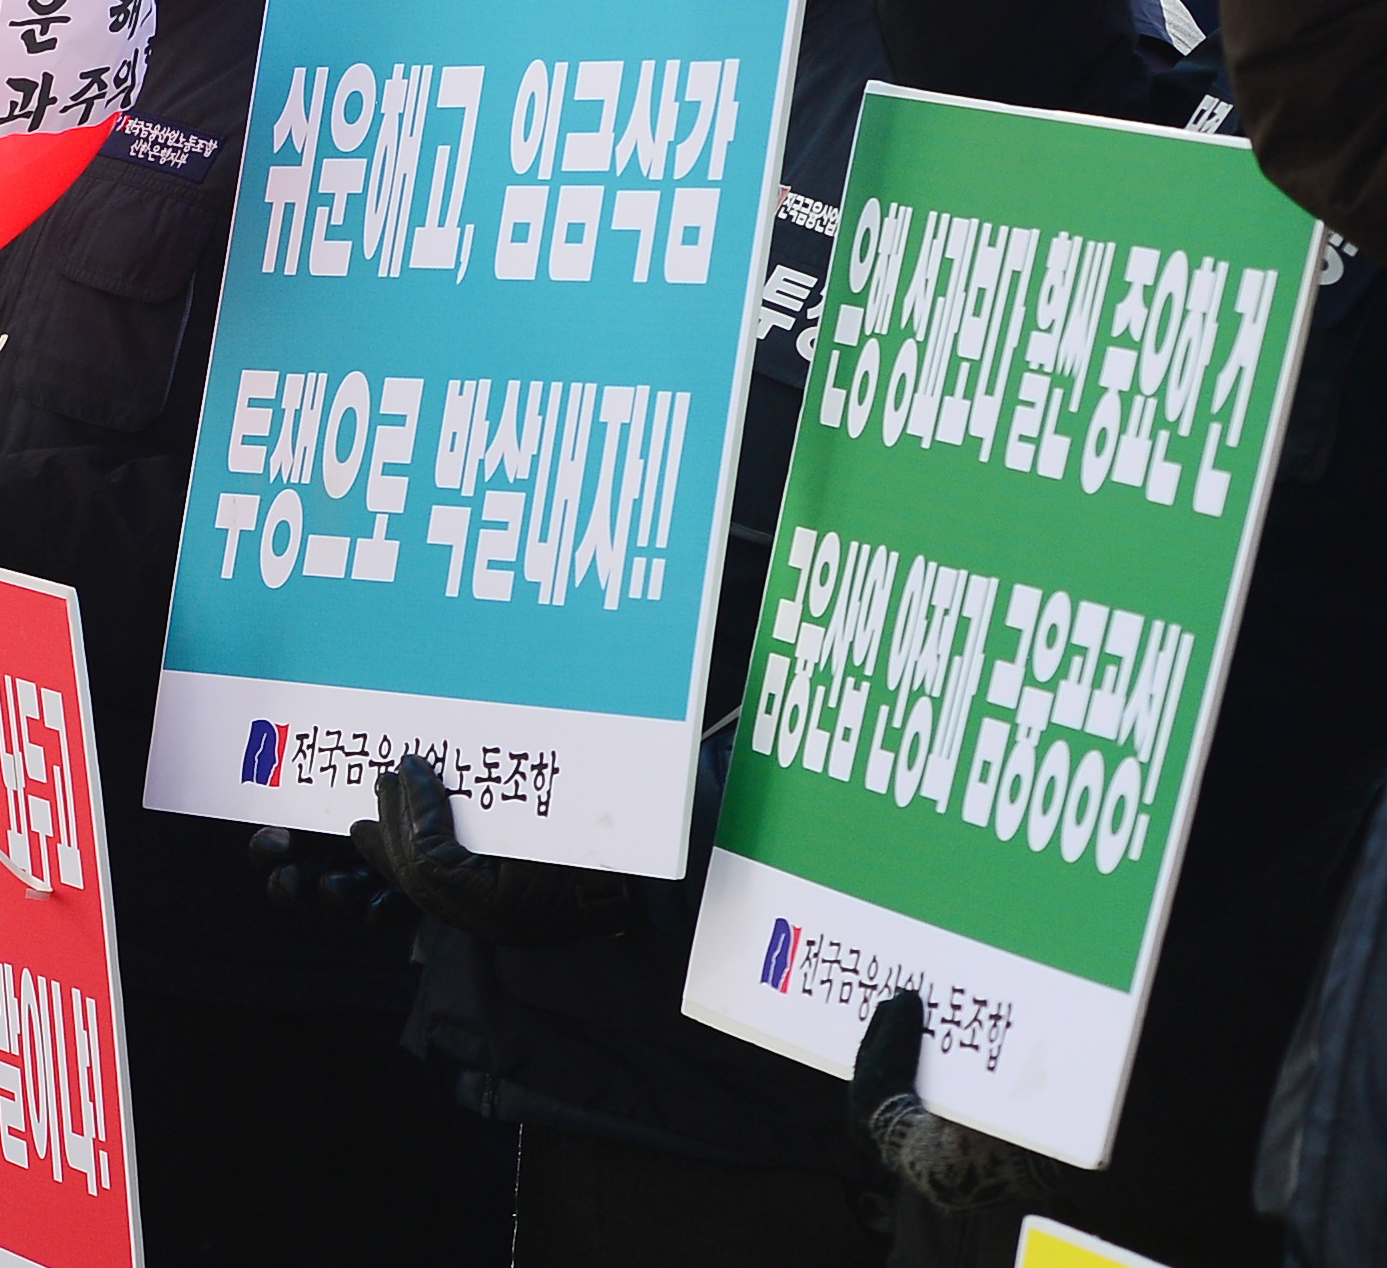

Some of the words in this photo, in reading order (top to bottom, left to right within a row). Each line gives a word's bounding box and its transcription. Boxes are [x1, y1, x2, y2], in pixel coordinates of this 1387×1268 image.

[261, 61, 487, 284] 쉬운해고,
[494, 58, 742, 285] 임금삭감
[213, 369, 424, 589] 투쟁으로
[426, 377, 691, 612] 박살내자!!
[819, 196, 912, 440] 은행
[882, 209, 1041, 464] 성과보다
[1003, 230, 1116, 481] 훨씬
[1078, 245, 1230, 506] 중요한
[1191, 266, 1278, 519] 건
[753, 526, 900, 784] 금융산업
[864, 552, 1001, 815] 안정과
[961, 582, 1194, 876] 금융공공성!
